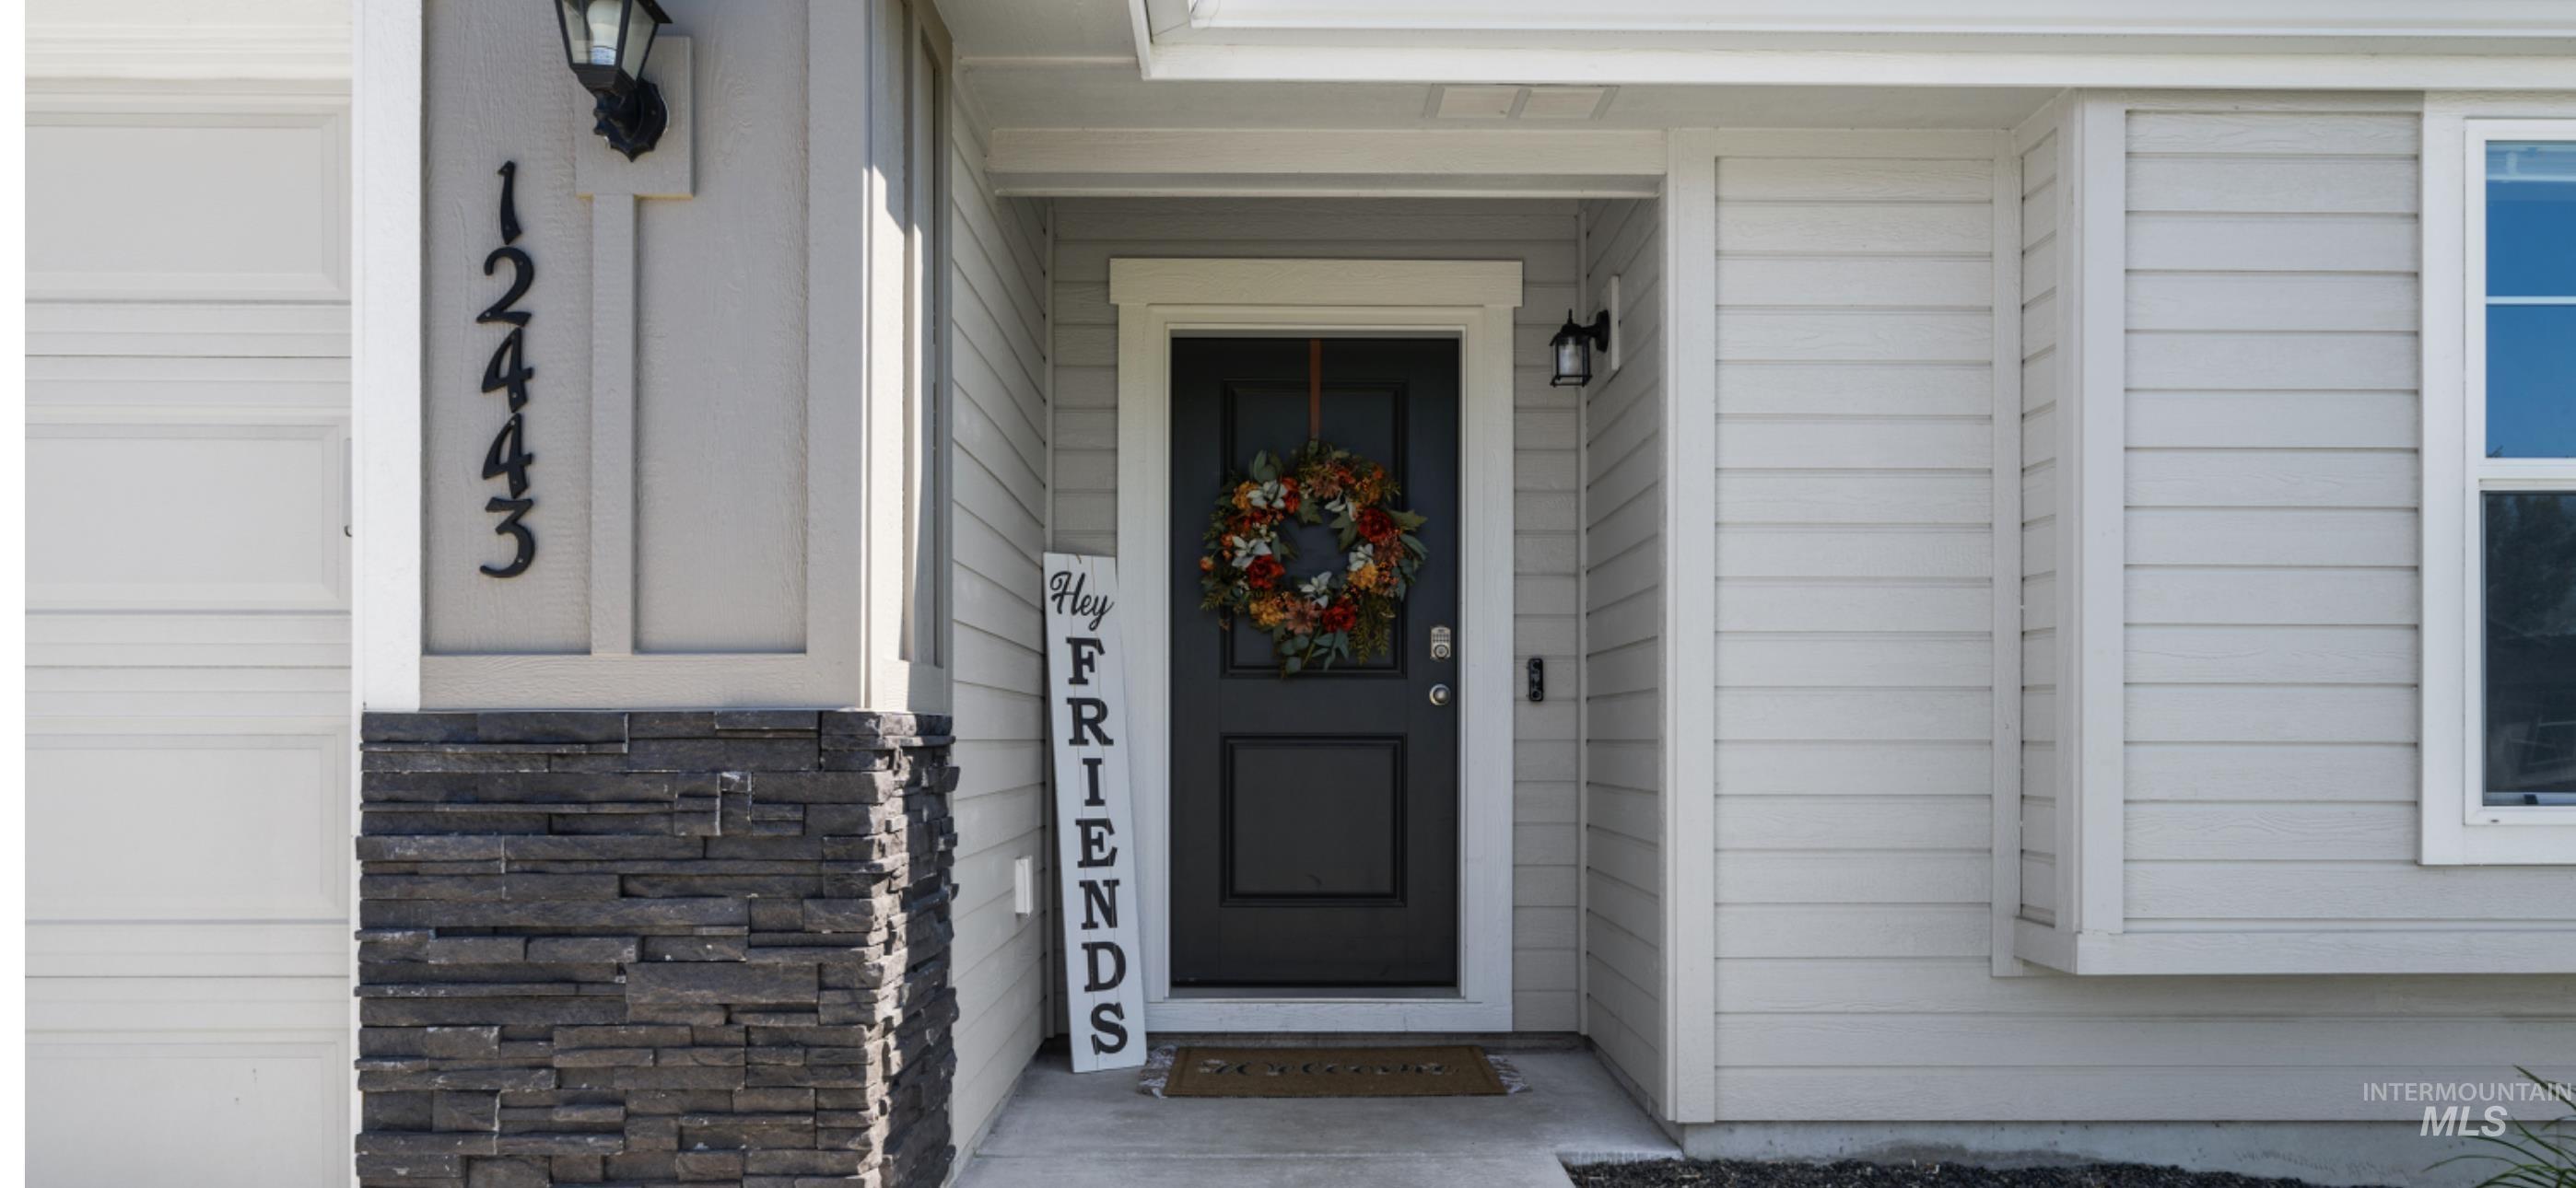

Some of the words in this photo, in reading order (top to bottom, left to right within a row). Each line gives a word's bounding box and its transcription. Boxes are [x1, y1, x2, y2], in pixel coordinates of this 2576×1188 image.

[475, 159, 536, 579] 12443
[1048, 570, 1115, 631] Hey
[1065, 636, 1129, 1055] FRIENDS
